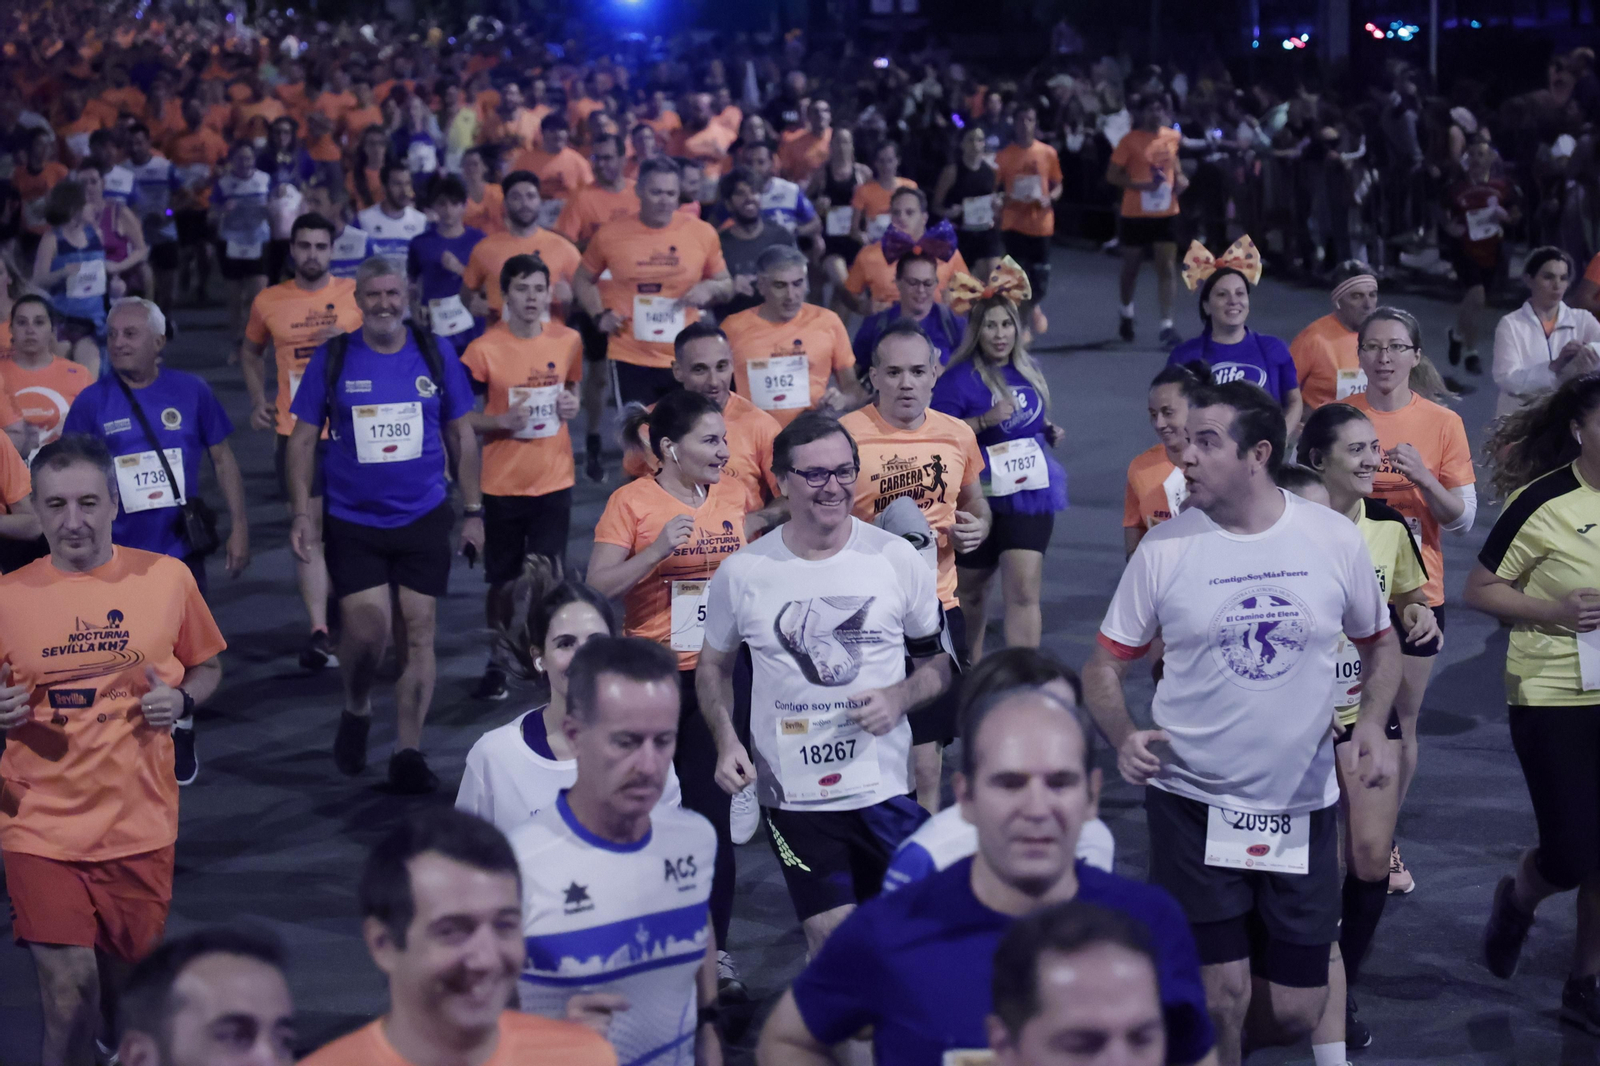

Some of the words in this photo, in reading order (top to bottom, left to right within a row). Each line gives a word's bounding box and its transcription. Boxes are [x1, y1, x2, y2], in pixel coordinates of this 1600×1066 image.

[764, 373, 794, 389] 9162
[369, 422, 411, 438] 17380
[1004, 454, 1036, 473] 17837
[133, 469, 167, 486] 1738
[879, 468, 924, 494] CARRERA
[696, 536, 740, 546] NOCTURNA
[673, 546, 718, 557] SEVILLA
[1234, 612, 1265, 622] Camino
[1266, 611, 1276, 619] de
[1277, 610, 1300, 618] Elena
[68, 630, 130, 642] NOCTURNA
[41, 643, 95, 658] SEVILLA
[774, 699, 809, 713] Contigo
[811, 702, 832, 712] soy
[799, 738, 857, 766] 18267
[1232, 811, 1292, 835] 20958
[663, 854, 698, 883] ACS
